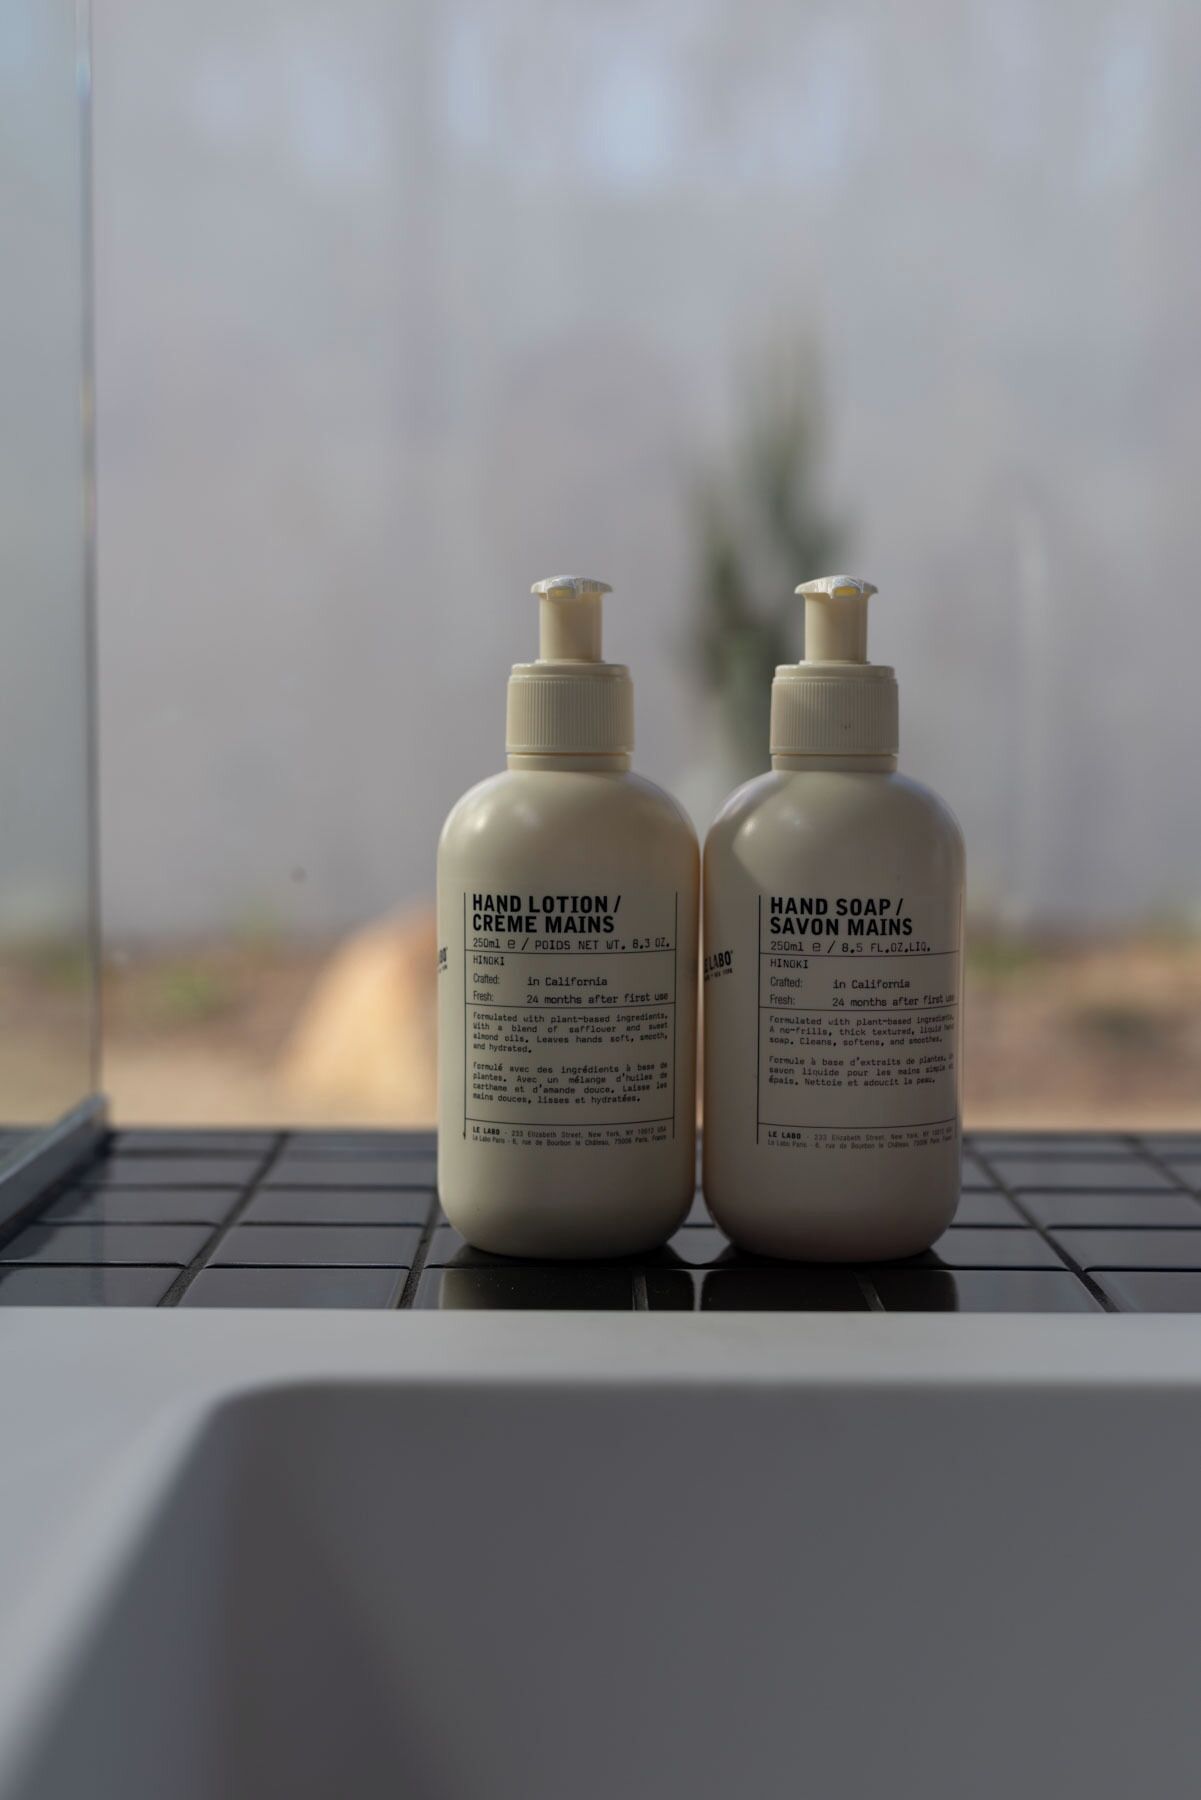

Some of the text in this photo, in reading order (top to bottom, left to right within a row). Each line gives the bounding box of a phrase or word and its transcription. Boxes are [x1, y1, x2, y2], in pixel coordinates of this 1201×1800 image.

[473, 894, 621, 914] HAND LOTION /
[770, 897, 903, 916] HAND SOAP /
[473, 909, 615, 934] CRÈME MAINS
[770, 917, 913, 936] SAVON MAINS
[473, 939, 500, 949] 250ml
[521, 938, 529, 951] /
[535, 940, 570, 950] POIDS
[579, 940, 599, 950] NET
[606, 940, 626, 950] WT.
[655, 938, 670, 948] OZ.
[770, 941, 804, 951] 250ml
[827, 941, 836, 954] /
[473, 956, 505, 966] HINOKI
[770, 959, 809, 969] HINOKI
[473, 974, 607, 986] Crafted: in California
[770, 977, 910, 989] Crafted: in California
[473, 991, 669, 1005] Fresh: 24 months after first use
[770, 995, 796, 1006] Fresh:
[832, 998, 844, 1007] 24
[850, 998, 887, 1007] months
[893, 997, 919, 1006] after
[923, 994, 943, 1005] first
[473, 1012, 517, 1022] Formulated
[523, 1015, 545, 1023] with
[551, 1015, 610, 1024] plant-based
[769, 1016, 822, 1025] Formulated
[828, 1018, 850, 1026] with
[856, 1018, 911, 1027] plant-based
[511, 1024, 537, 1033] blend
[547, 1025, 558, 1033] of
[569, 1025, 617, 1033] safflower
[626, 1024, 641, 1032] and
[769, 1025, 775, 1033] A
[839, 1028, 866, 1036] thick
[473, 1032, 499, 1041] almond
[536, 1036, 569, 1044] Leaves
[576, 1035, 602, 1044] hands
[890, 1038, 905, 1046] and
[822, 1058, 844, 1066] base
[537, 1065, 553, 1074] des
[561, 1065, 619, 1075] ingrédients
[769, 1067, 795, 1075] savon
[802, 1067, 840, 1077] liquide
[847, 1070, 868, 1078] pour
[877, 1068, 891, 1076] les
[517, 1075, 537, 1083] Avec
[569, 1075, 606, 1085] mélange
[805, 1078, 843, 1087] Nettoie
[848, 1079, 859, 1087] et
[864, 1078, 899, 1087] adoucit
[473, 1082, 507, 1092] carthame
[623, 1084, 650, 1093] Laisse
[656, 1081, 668, 1089] les
[473, 1092, 494, 1101] mains
[538, 1096, 569, 1104] lisses
[473, 1126, 480, 1134] LE
[484, 1128, 501, 1136] LABO
[782, 1132, 802, 1140] LABO
